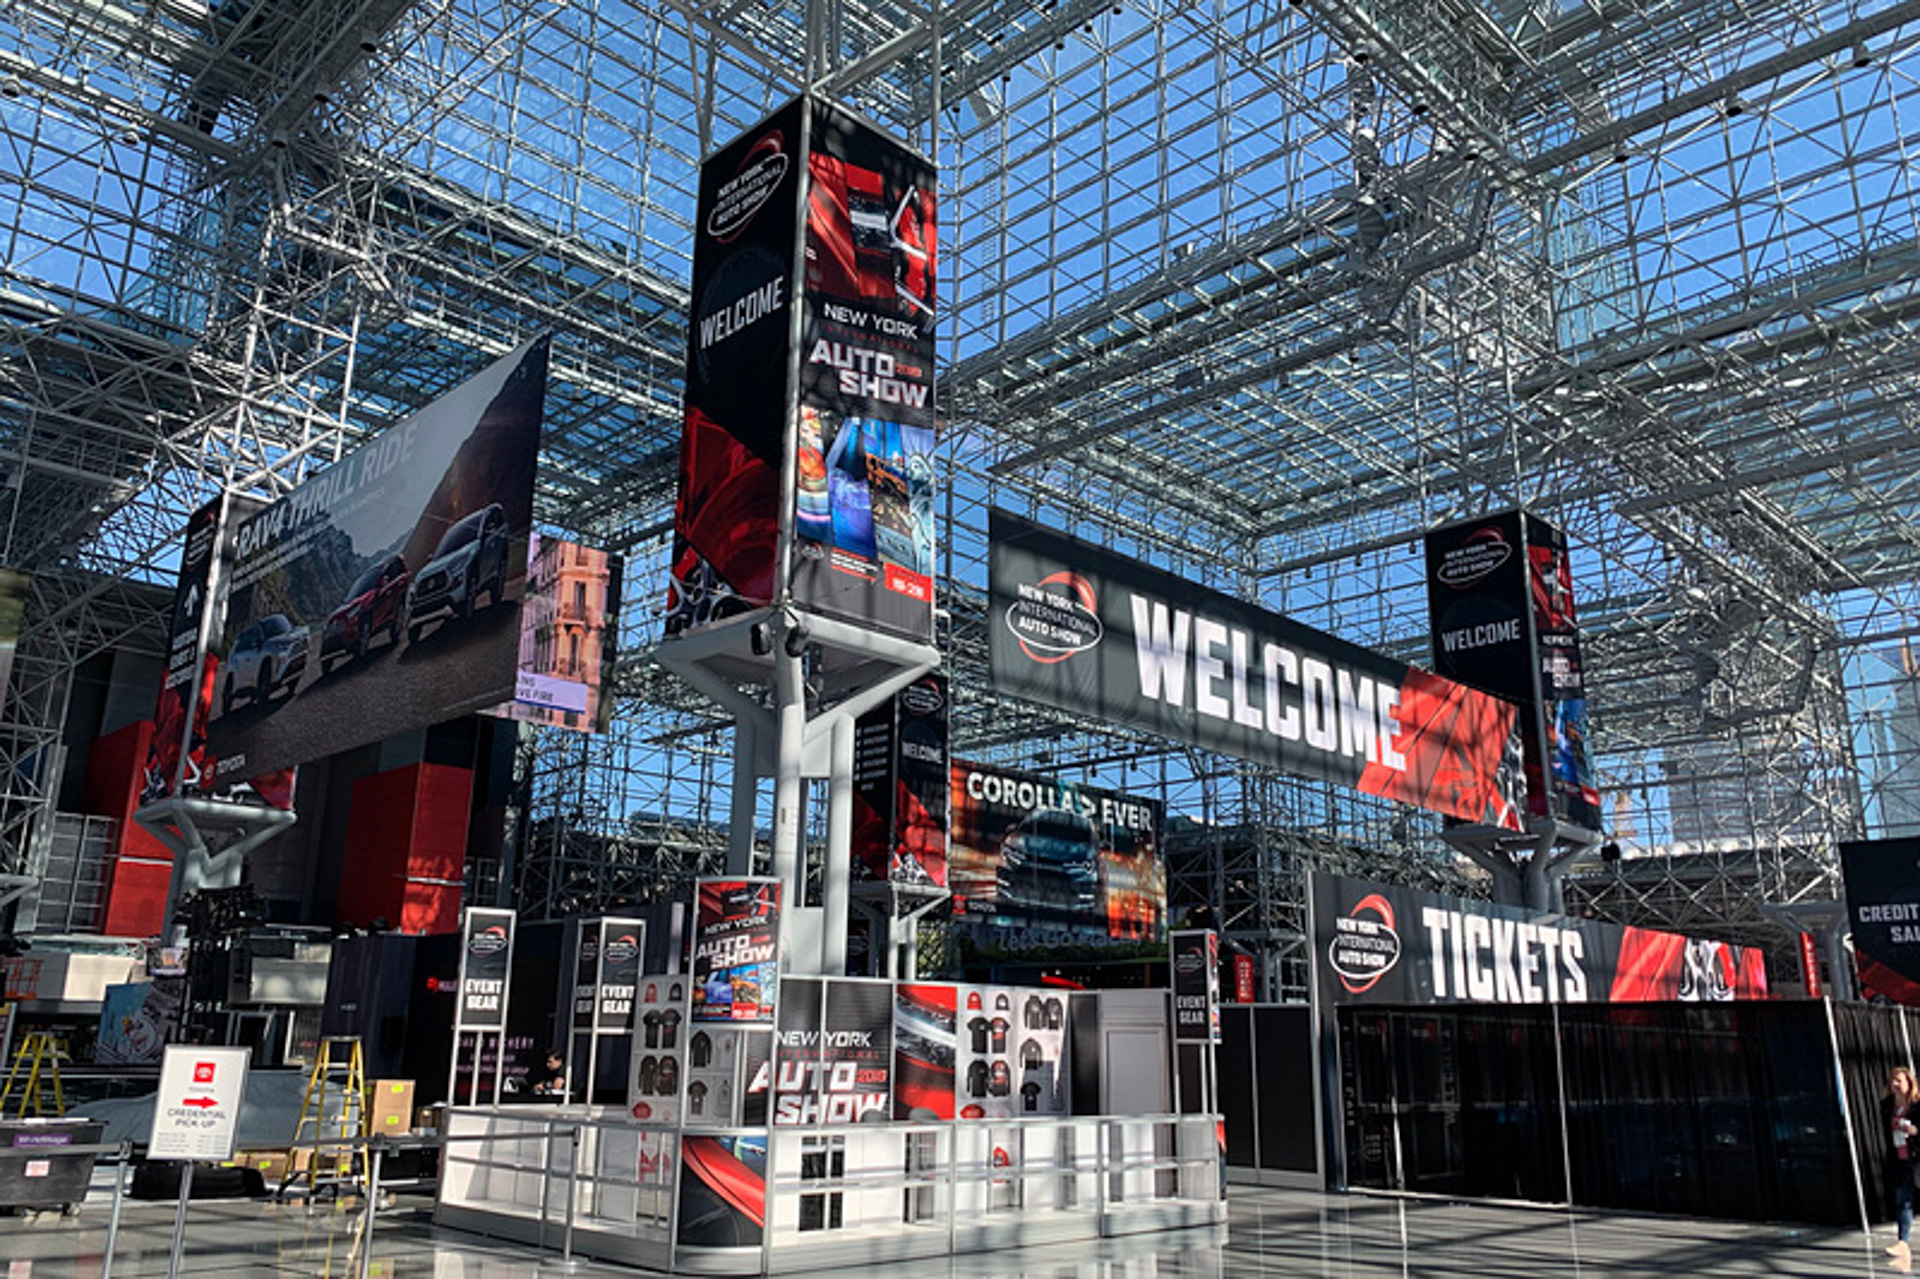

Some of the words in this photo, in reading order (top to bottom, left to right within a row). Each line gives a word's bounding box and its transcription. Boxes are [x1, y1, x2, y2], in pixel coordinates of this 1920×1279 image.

[700, 275, 783, 349] WELCOME
[823, 302, 868, 328] NEW
[872, 313, 919, 341] YORK
[808, 338, 895, 379] AUTO
[839, 368, 929, 409] SHOW
[235, 500, 290, 560] RAV4
[287, 460, 357, 531] THRILL
[359, 422, 419, 489] RIDE
[1017, 583, 1045, 602] NEW
[1046, 591, 1075, 613] YORK
[1018, 600, 1098, 637] INTERNATIONAL
[1018, 616, 1050, 636] AUTO
[1050, 625, 1082, 646] SHOW
[1441, 618, 1521, 653] WELCOME
[1129, 593, 1407, 772] WELCOME
[1101, 797, 1153, 832] EVER
[969, 902, 996, 913] TOYOTA
[1859, 903, 1919, 922] CREDIT
[704, 920, 732, 935] NEW
[734, 914, 769, 929] YORK
[1336, 916, 1357, 932] NEW
[1357, 921, 1379, 935] YORK
[696, 934, 751, 960] AUTO
[1337, 932, 1396, 954] INTERNATIONAL
[1422, 906, 1588, 1004] TICKETS
[710, 943, 776, 970] SHOW
[1338, 949, 1362, 965] AUTO
[1362, 952, 1386, 967] SHOW
[464, 978, 503, 995] EVENT
[601, 985, 636, 1000] EVENT
[466, 995, 499, 1011] GEAR
[601, 1000, 632, 1015] GEAR
[1177, 995, 1206, 1009] EVENT
[1179, 1010, 1205, 1024] GEAR
[776, 1031, 819, 1047] NEW
[824, 1031, 872, 1047] YORK
[747, 1061, 858, 1093] AUTO
[167, 1108, 226, 1119] CREDENTIAL
[775, 1092, 888, 1125] SHOW
